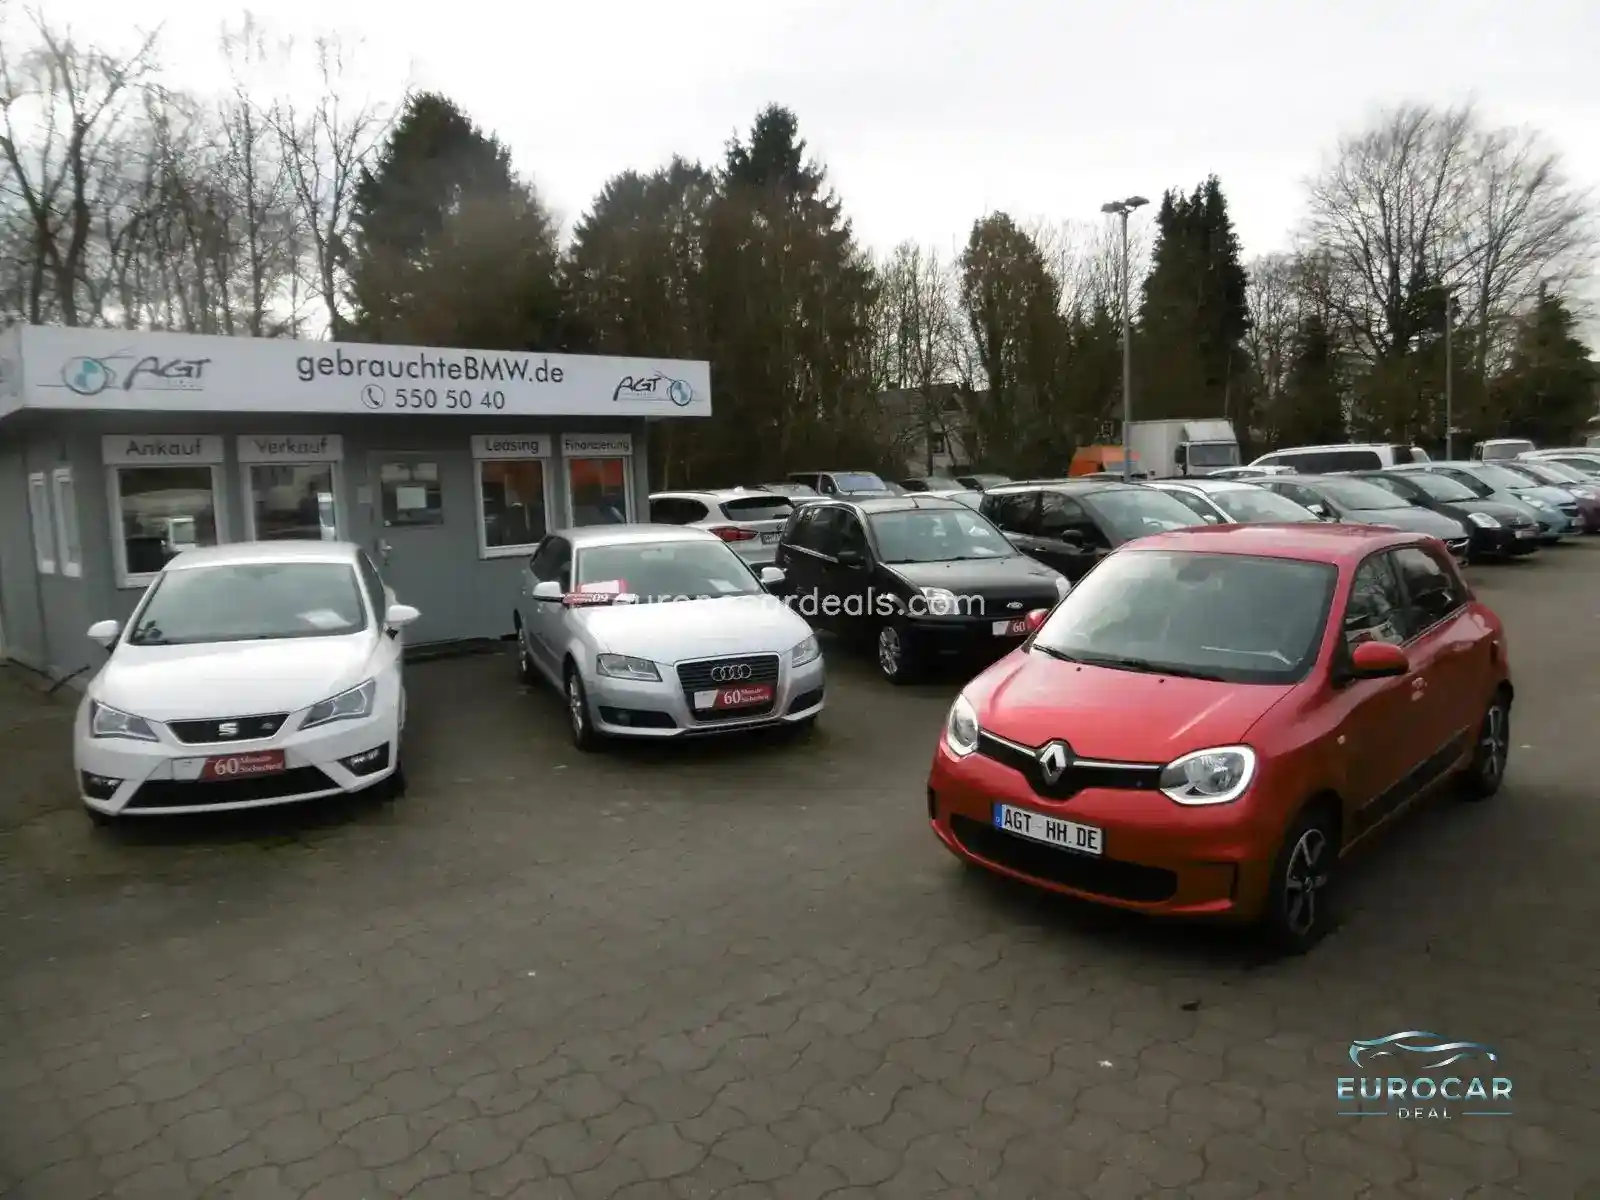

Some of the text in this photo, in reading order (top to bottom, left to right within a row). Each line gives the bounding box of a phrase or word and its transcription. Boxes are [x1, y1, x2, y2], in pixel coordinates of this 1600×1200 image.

[122, 356, 211, 391] AGT
[296, 349, 563, 383] gebrauchteBMW.de
[613, 375, 662, 402] AGT
[395, 388, 505, 410] 550 50 40
[125, 439, 203, 456] Ankauf
[255, 437, 328, 455] Verkauf
[485, 438, 539, 455] Leasing
[723, 689, 741, 705] 60
[214, 758, 238, 775] 60
[1004, 808, 1032, 833] AGT
